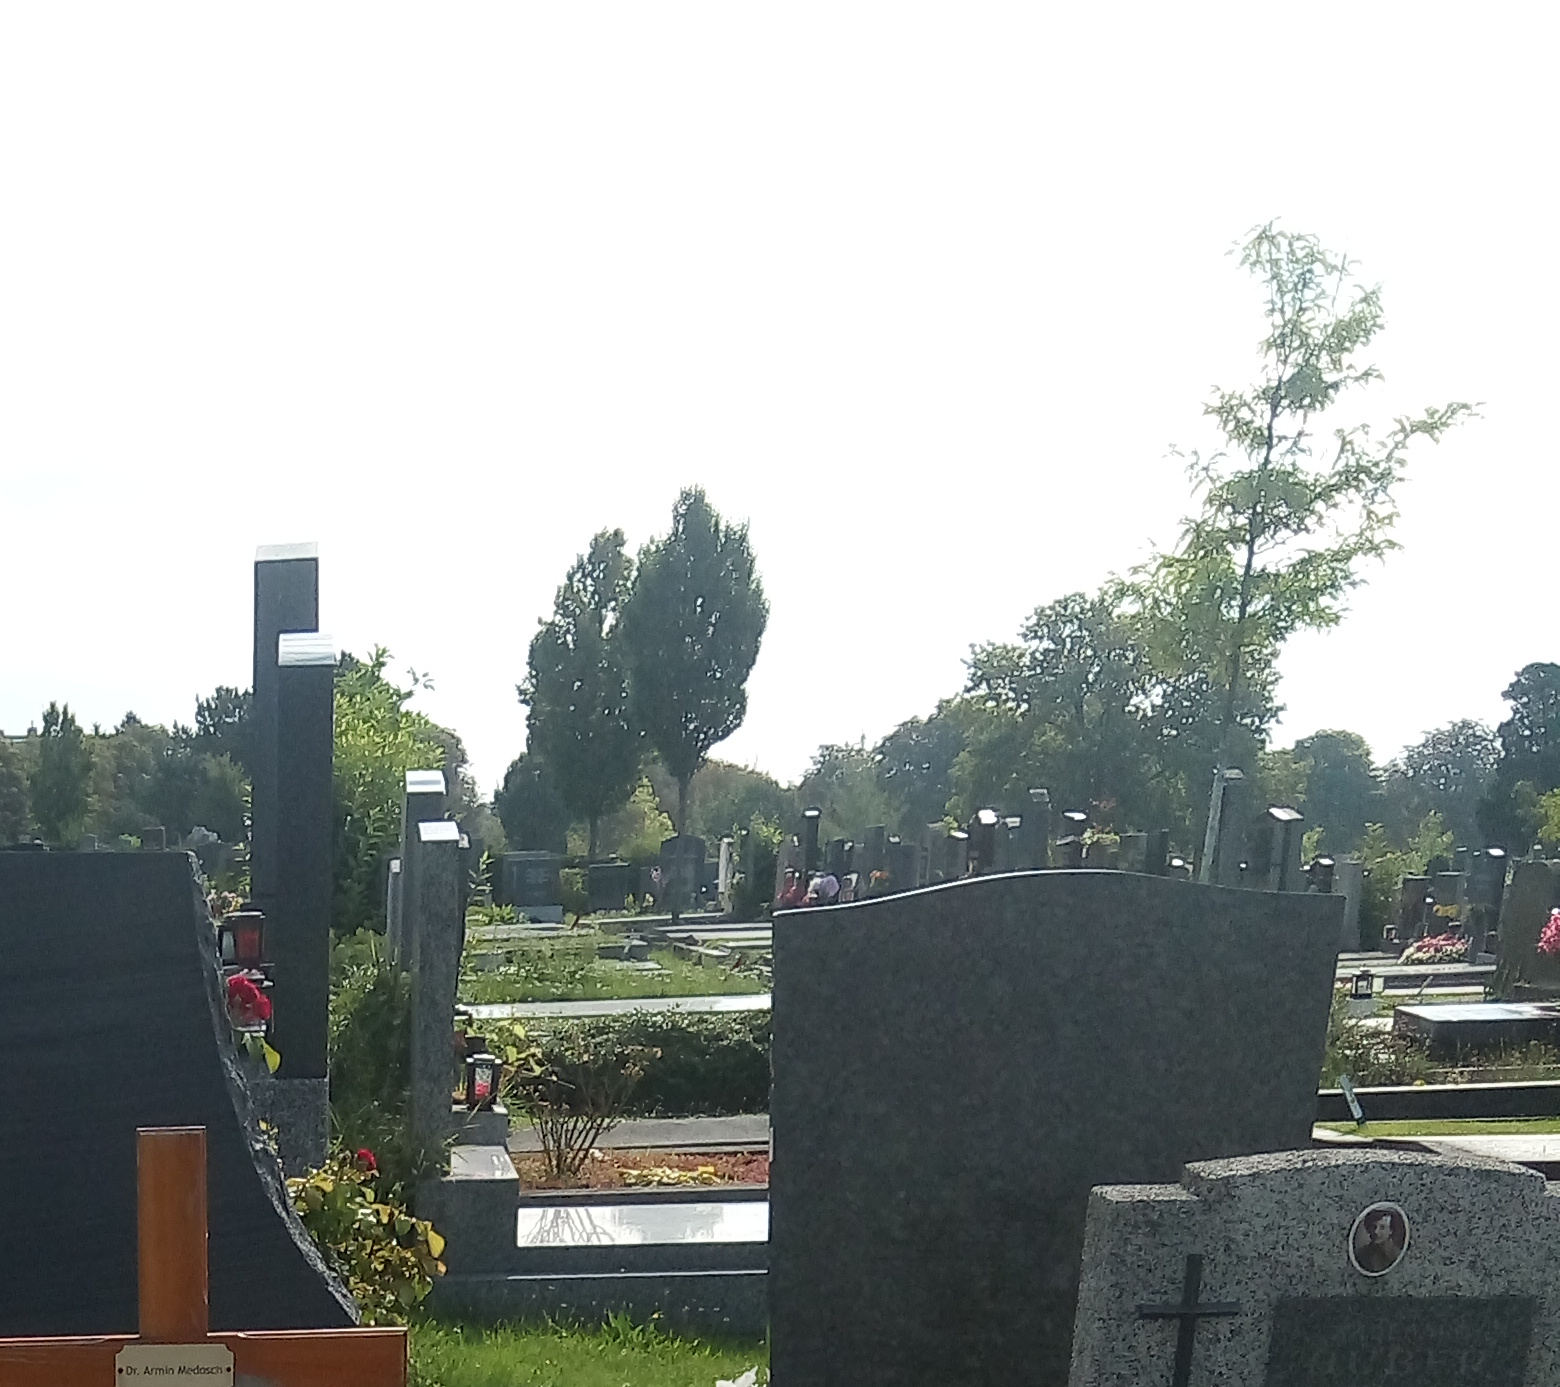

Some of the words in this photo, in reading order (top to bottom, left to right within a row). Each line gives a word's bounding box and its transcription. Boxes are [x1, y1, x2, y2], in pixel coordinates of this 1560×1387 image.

[125, 1365, 140, 1377] Dr.
[143, 1365, 175, 1376] Armin
[177, 1363, 223, 1376] Medosch
